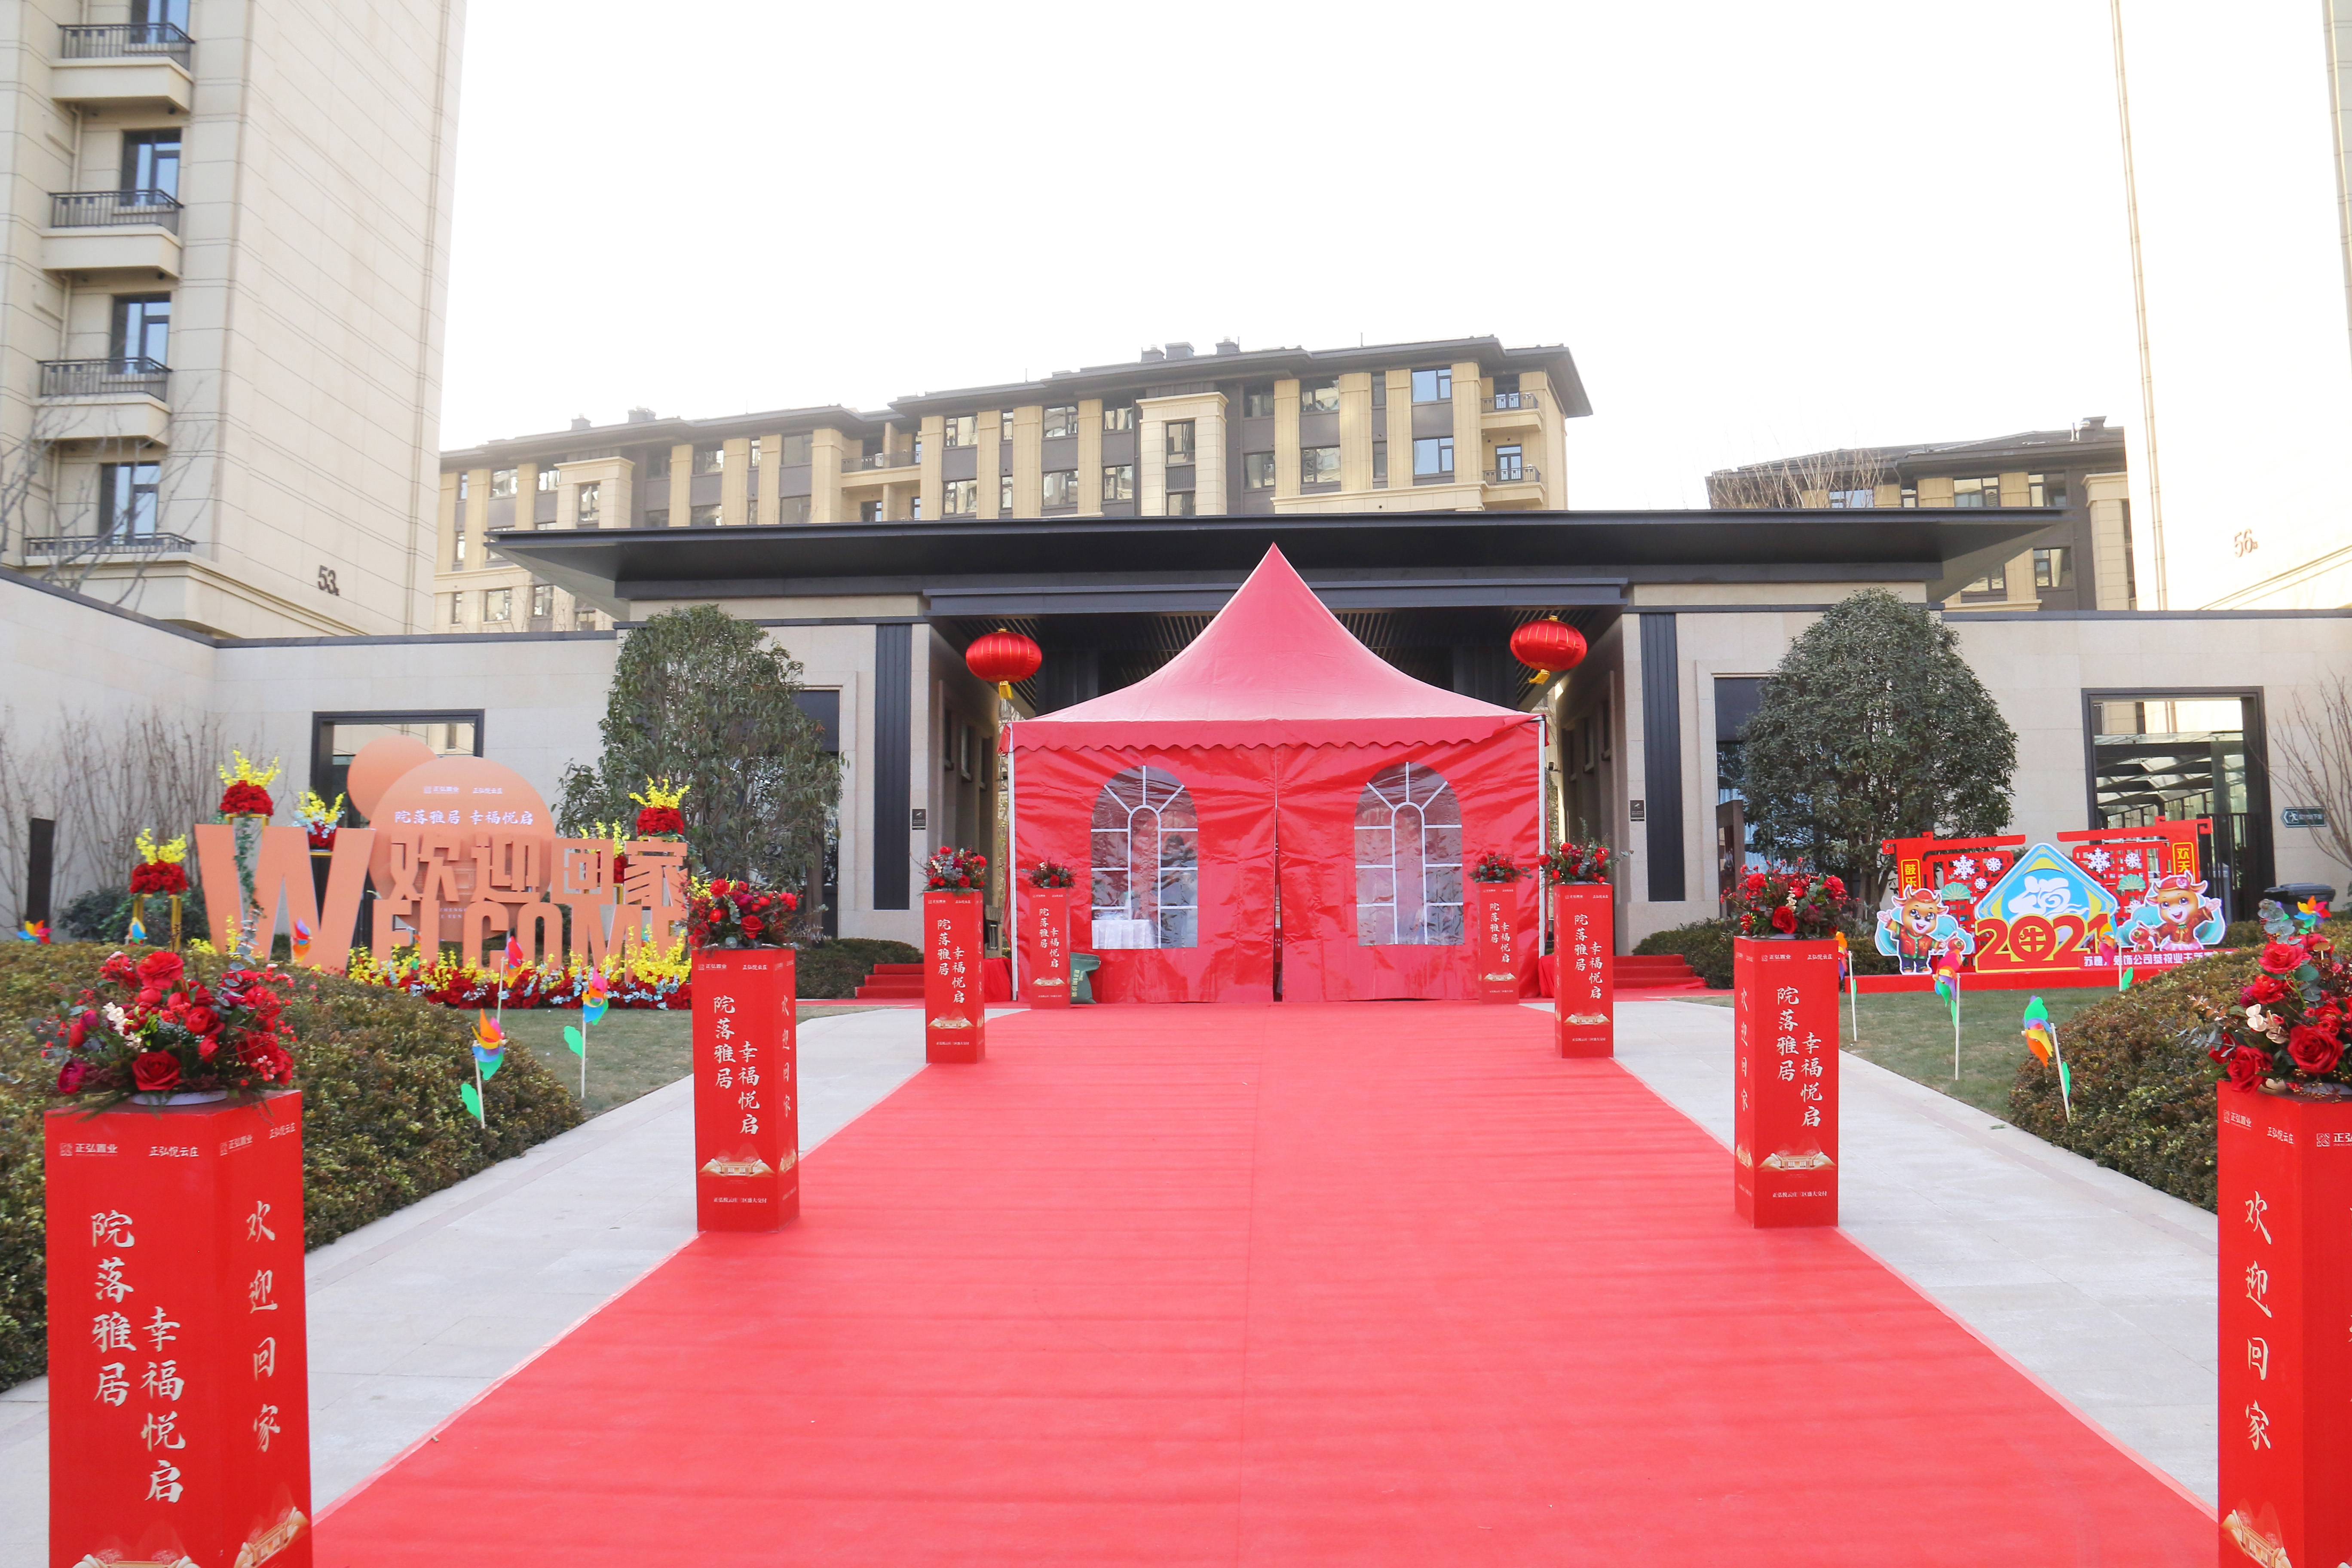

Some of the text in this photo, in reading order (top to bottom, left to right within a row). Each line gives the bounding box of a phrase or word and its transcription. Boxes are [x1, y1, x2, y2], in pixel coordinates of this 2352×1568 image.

[394, 809, 533, 825] 院落雅居 幸福悦启
[389, 832, 688, 907] 欢迎回家
[1905, 864, 1917, 891] 鼓乐
[937, 919, 952, 976] 院落雅居
[950, 946, 966, 1004] 幸福悦启
[1574, 914, 1589, 972] 院落雅居
[1587, 941, 1604, 999] 幸福悦启
[714, 995, 737, 1090] 院落雅居
[1776, 986, 1800, 1082] 院落雅居
[1800, 1032, 1824, 1127] 幸福悦启
[738, 1041, 761, 1135] 幸福悦启
[91, 1210, 138, 1407] 院落雅居
[246, 1200, 281, 1453] 欢迎回家
[2245, 1191, 2273, 1451] 欢迎回家
[140, 1306, 187, 1504] 幸福悦启
